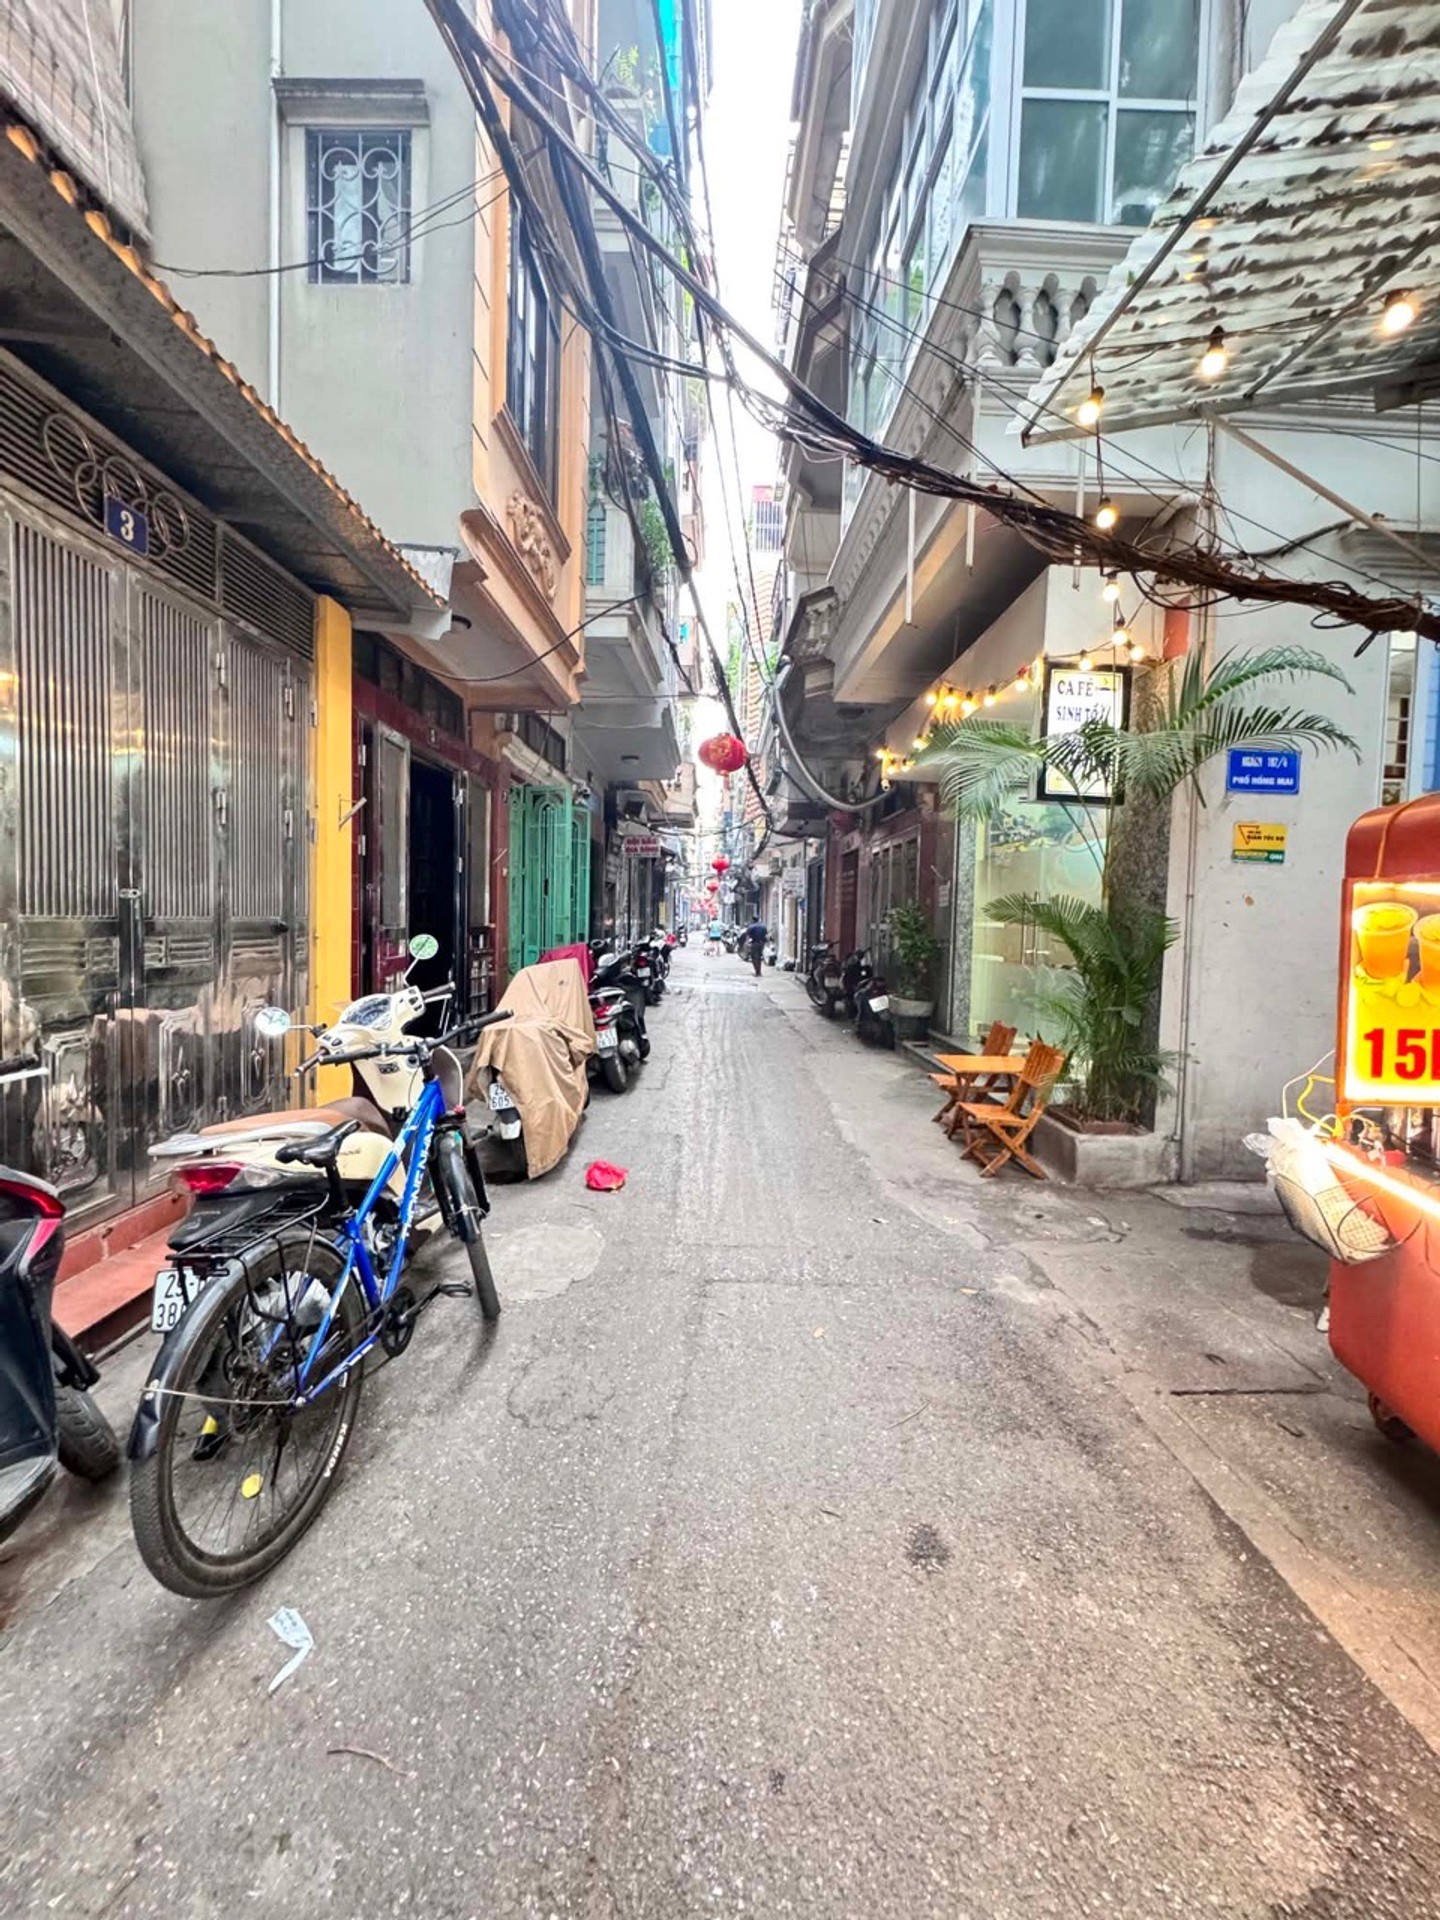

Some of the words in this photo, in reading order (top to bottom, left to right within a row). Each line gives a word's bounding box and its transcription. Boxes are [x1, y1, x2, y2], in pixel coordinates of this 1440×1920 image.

[120, 510, 135, 542] 3
[1056, 705, 1082, 722] SINH
[1276, 776, 1294, 786] MAI
